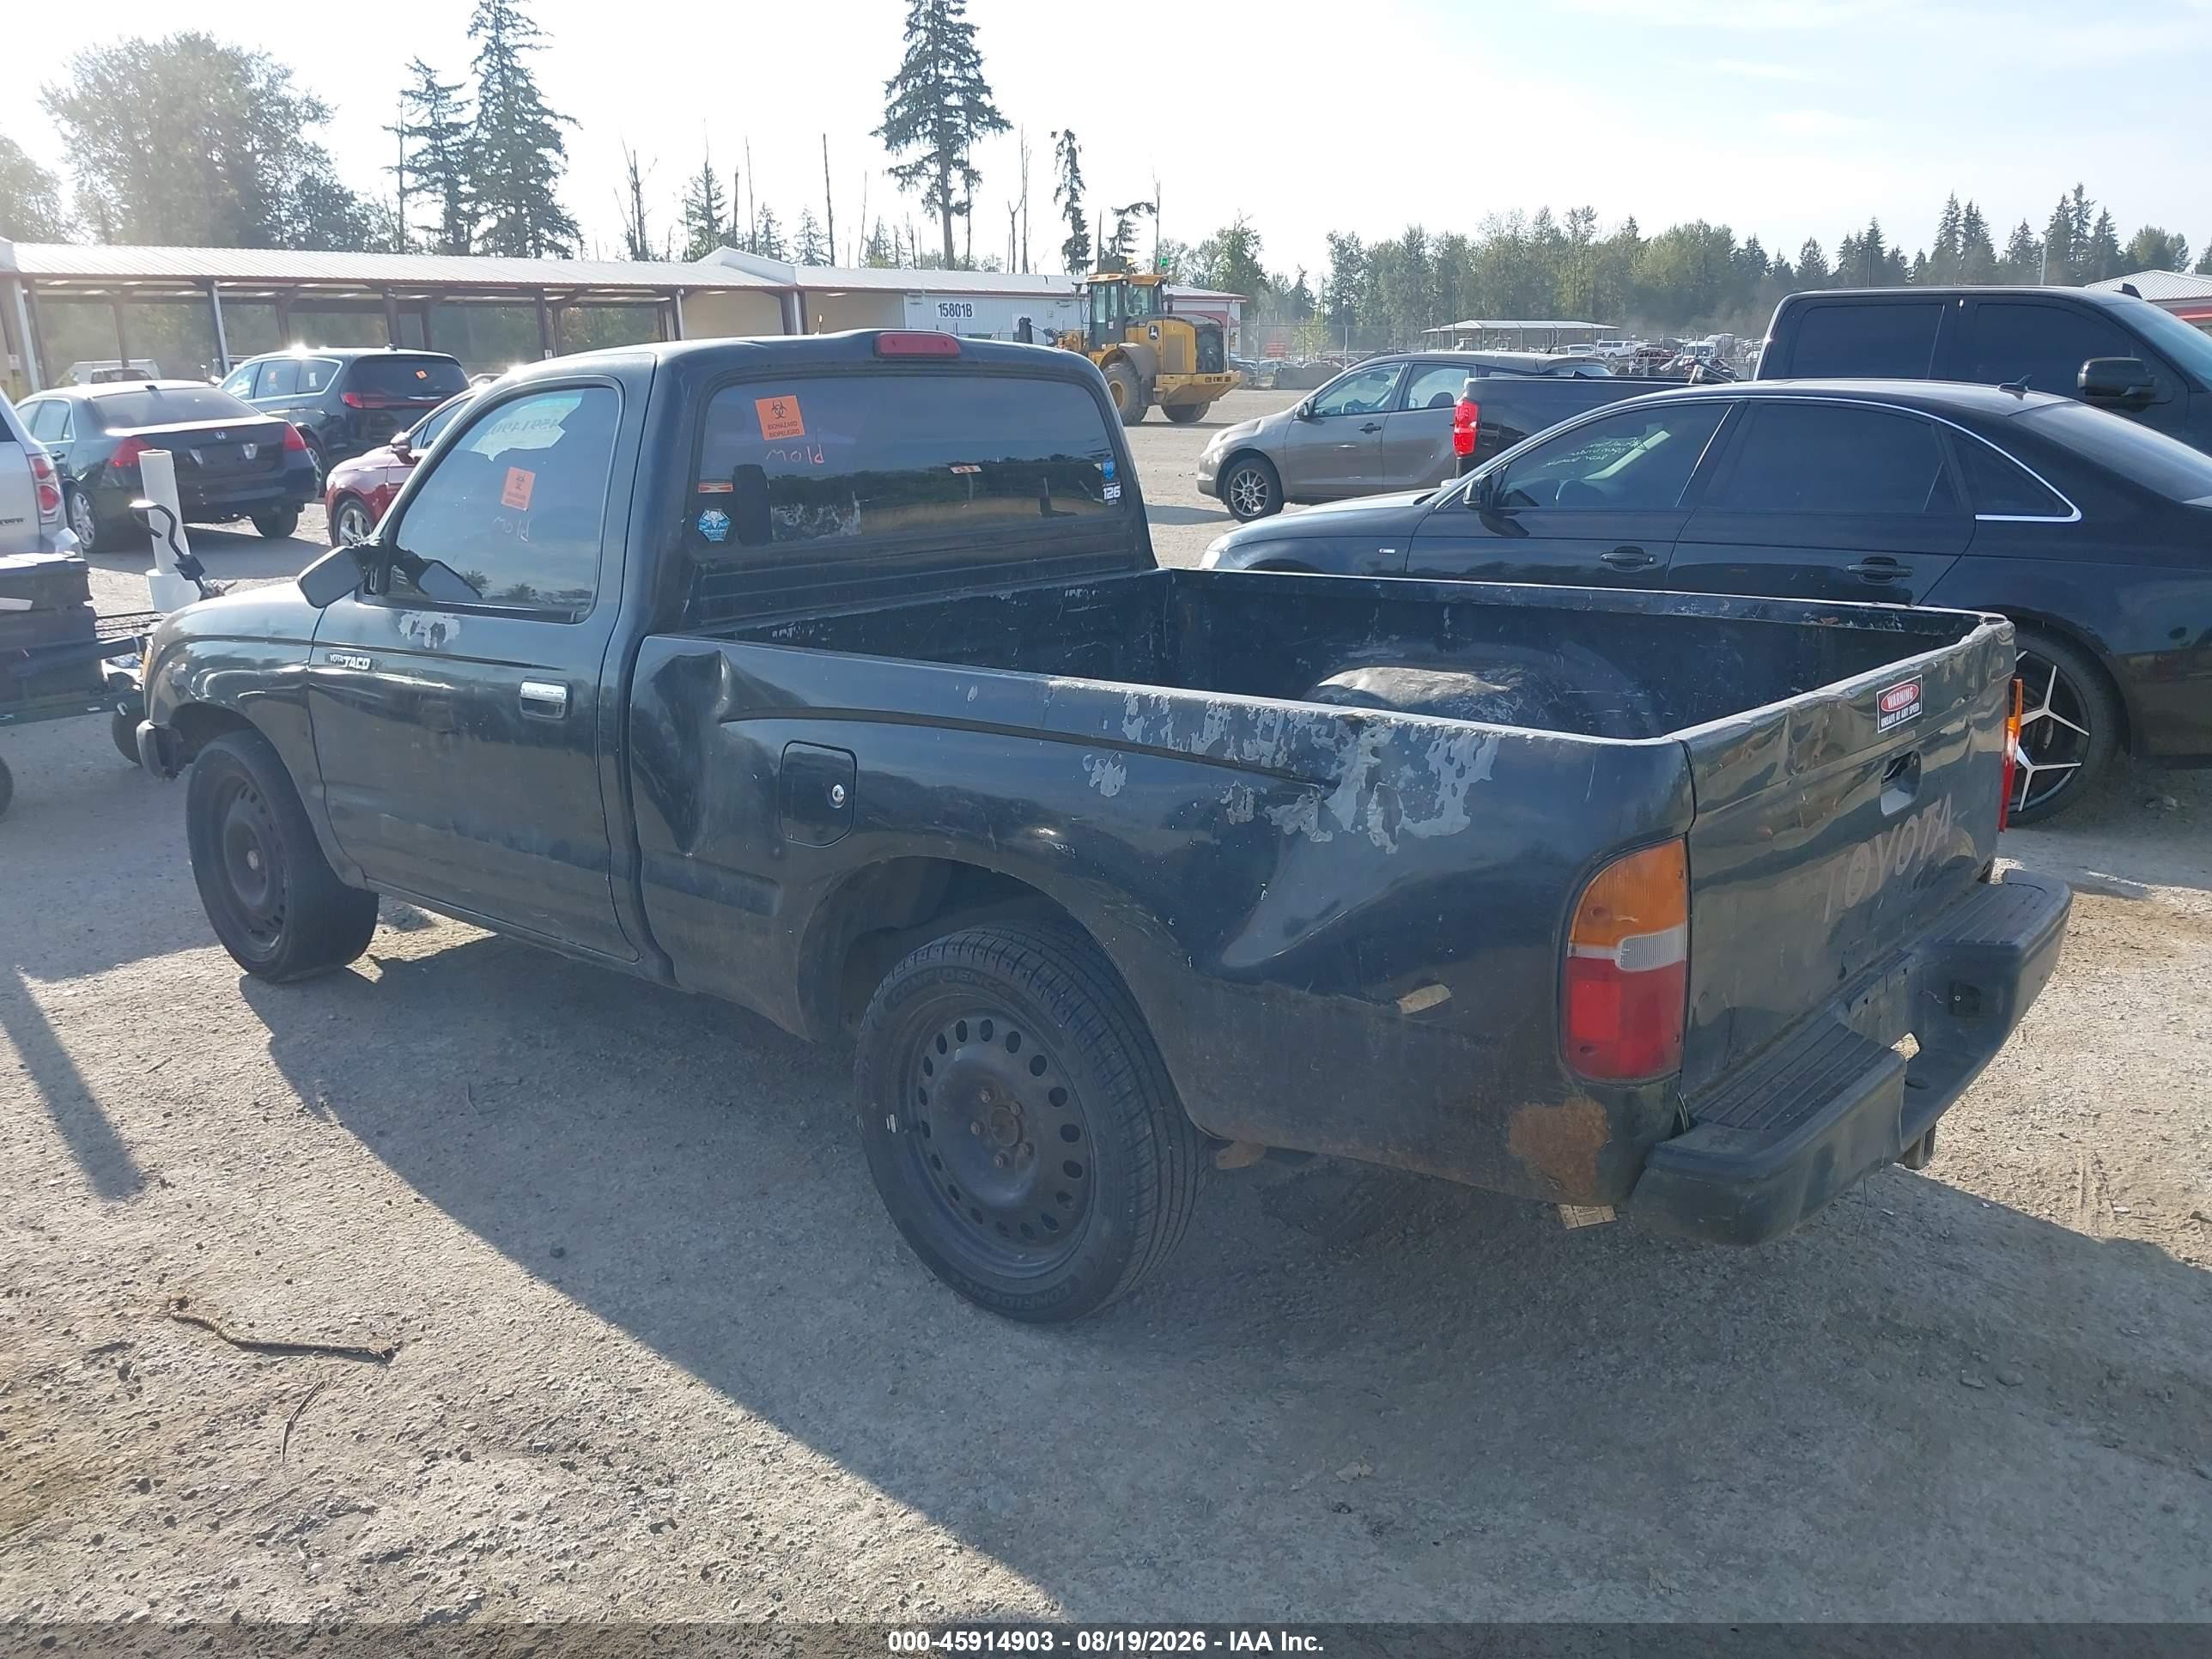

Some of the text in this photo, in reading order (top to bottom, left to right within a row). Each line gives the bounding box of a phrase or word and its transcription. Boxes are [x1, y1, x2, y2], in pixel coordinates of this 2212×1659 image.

[938, 302, 973, 318] 15801B
[1103, 485, 1121, 500] 126
[1887, 686, 1914, 709] WARNING
[1909, 702, 1920, 715] SPEED
[1822, 792, 1952, 924] TOYOTA
